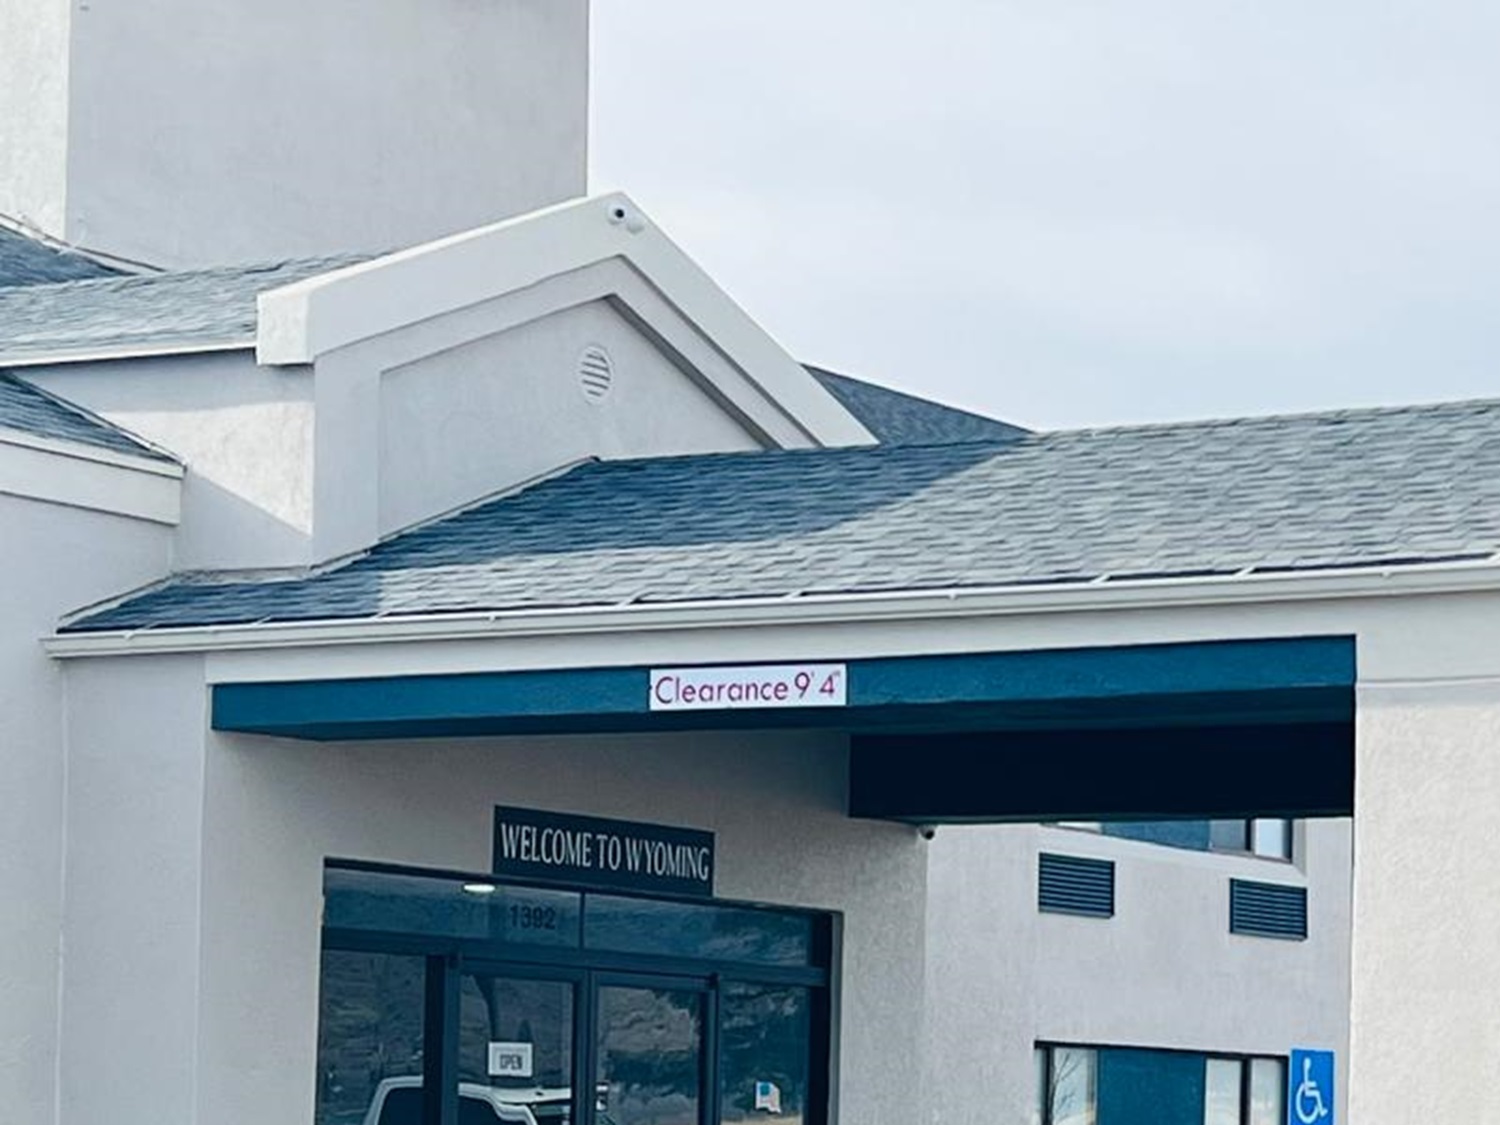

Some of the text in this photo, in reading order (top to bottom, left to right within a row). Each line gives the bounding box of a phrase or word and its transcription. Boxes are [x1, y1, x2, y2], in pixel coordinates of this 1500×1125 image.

[655, 676, 788, 704] Clearance
[501, 823, 710, 881] WELCOME TO WYOMING
[509, 904, 557, 930] 1392
